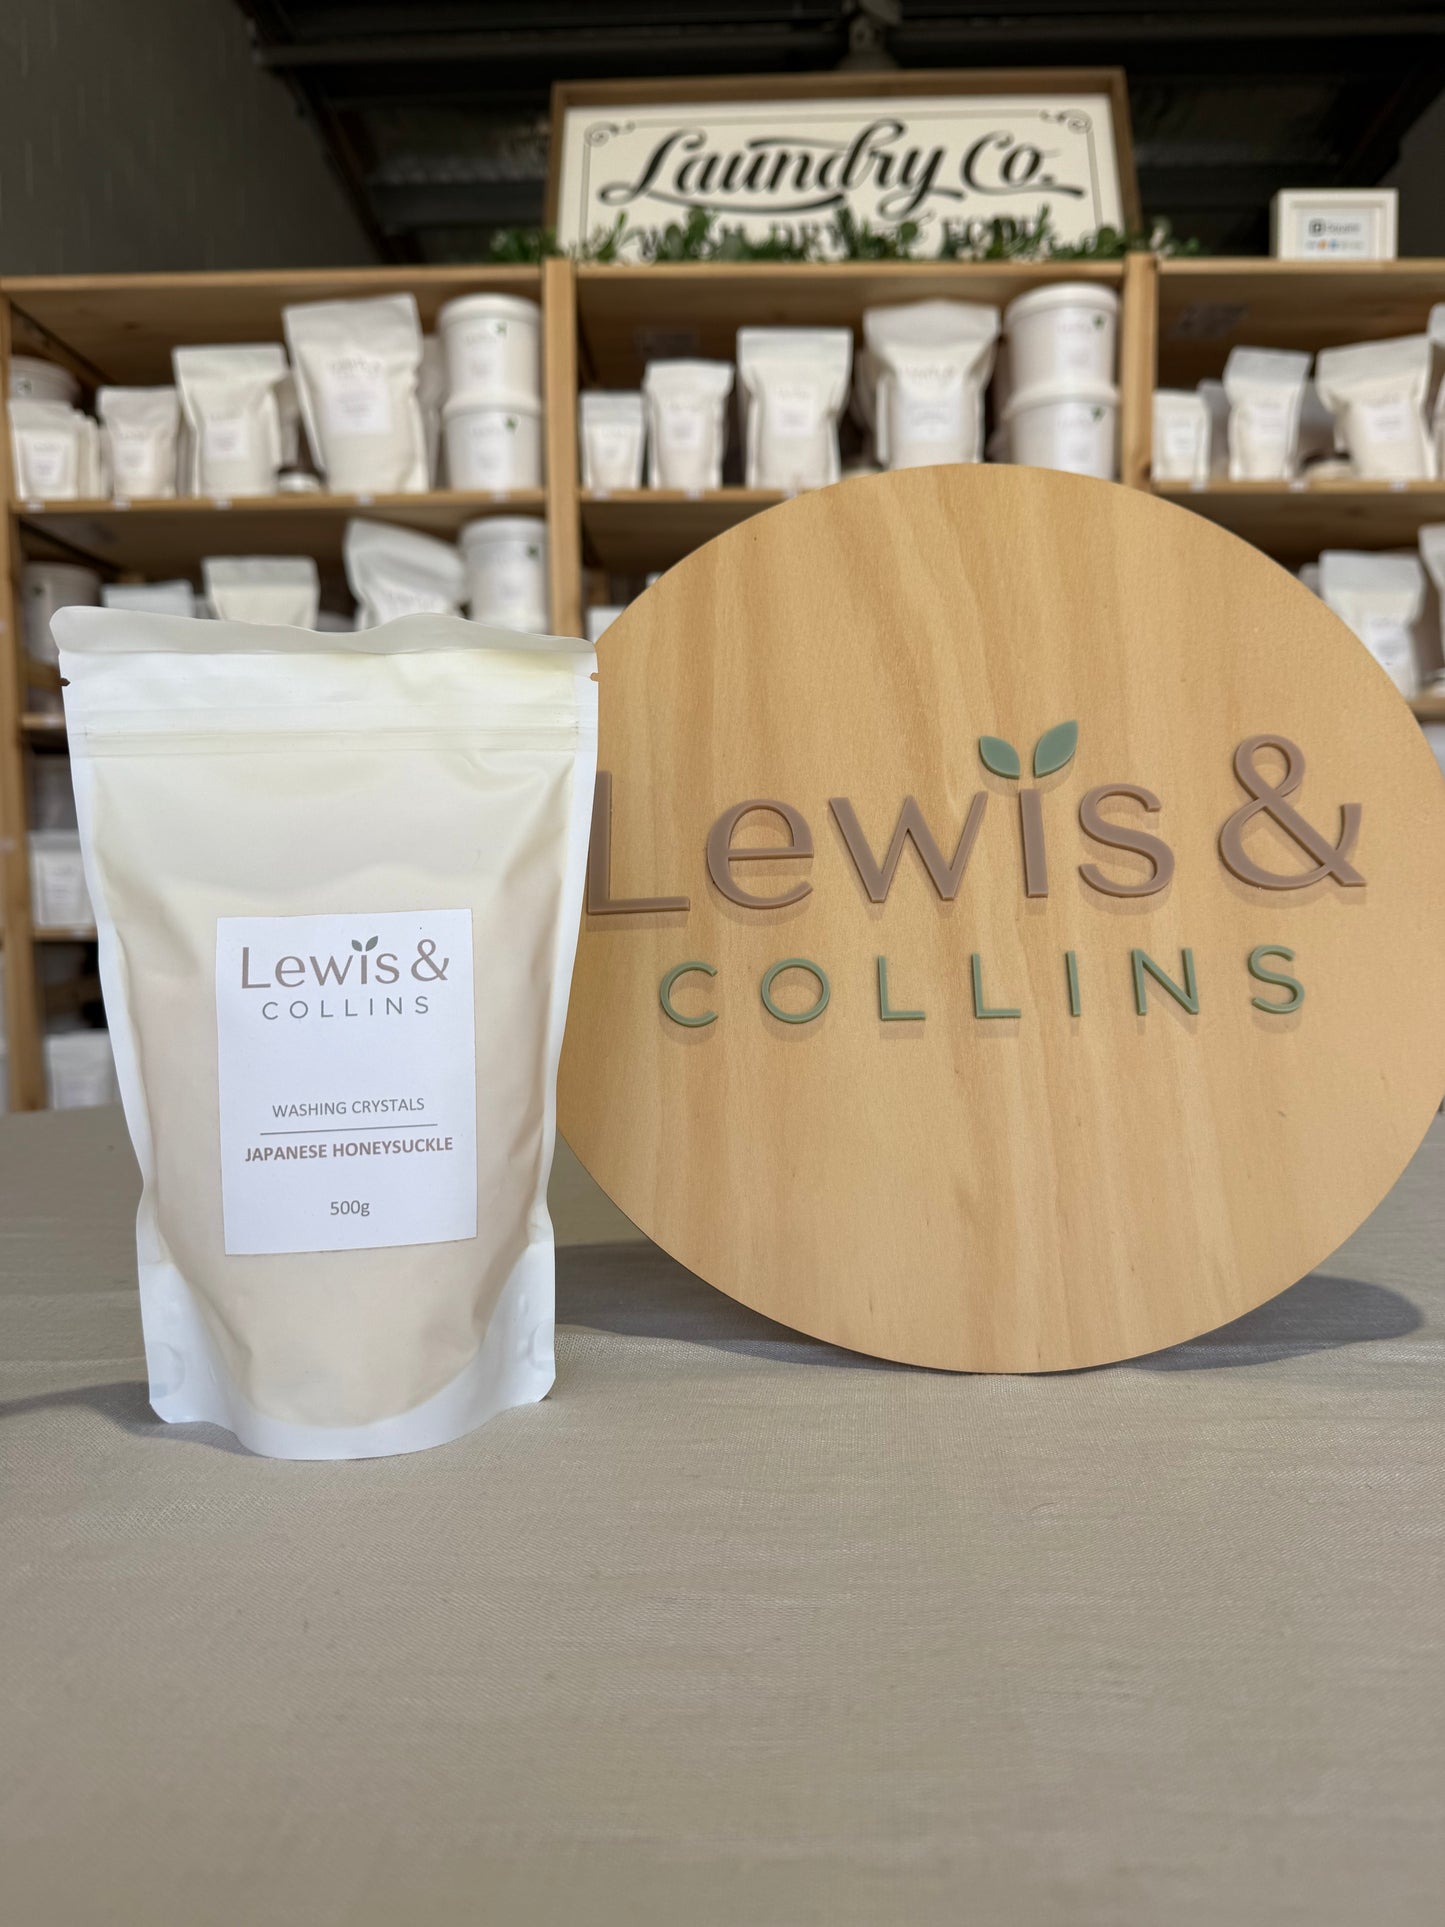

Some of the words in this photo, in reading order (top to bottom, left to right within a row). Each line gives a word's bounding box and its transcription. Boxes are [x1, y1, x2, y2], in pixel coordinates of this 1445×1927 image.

[597, 118, 966, 221] Laundry
[961, 130, 1085, 199] Co.
[586, 720, 1176, 917] Lewis
[1217, 734, 1367, 892] &
[241, 936, 400, 989] Lewis
[410, 938, 450, 982] &
[659, 945, 1306, 1029] COLLINS
[262, 996, 429, 1020] COLLINS
[272, 1101, 347, 1118] WASHING
[351, 1097, 425, 1115] CRYSTALS
[245, 1144, 327, 1163] JAPANESE
[332, 1137, 453, 1158] HONEYSUCKLE
[330, 1200, 370, 1217] 500g
